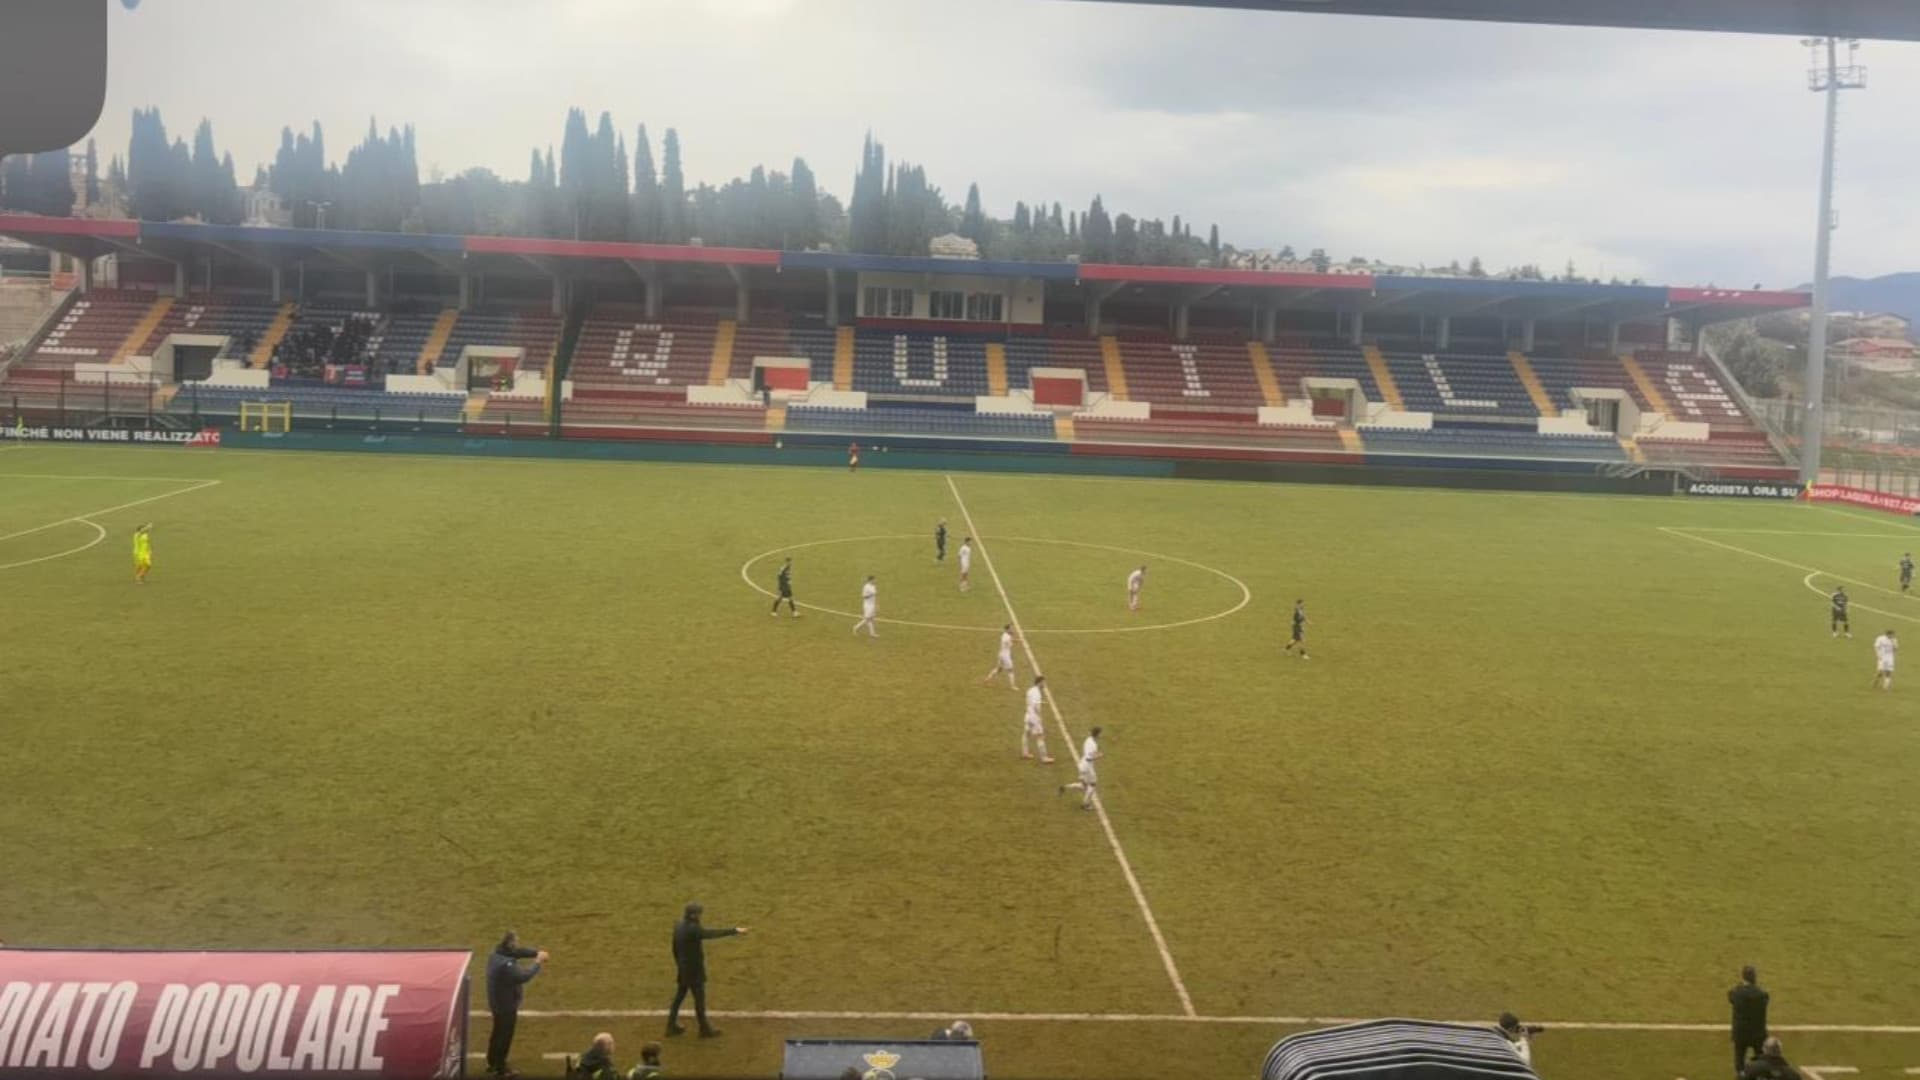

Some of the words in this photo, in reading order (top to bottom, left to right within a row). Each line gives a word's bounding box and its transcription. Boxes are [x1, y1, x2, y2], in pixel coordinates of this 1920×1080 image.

[54, 428, 84, 439] NON
[88, 430, 129, 440] VIENE
[1690, 484, 1749, 495] ACQUISTA
[1752, 486, 1777, 497] ORA
[1782, 487, 1798, 498] SU
[140, 982, 400, 1072] POPOLARE
